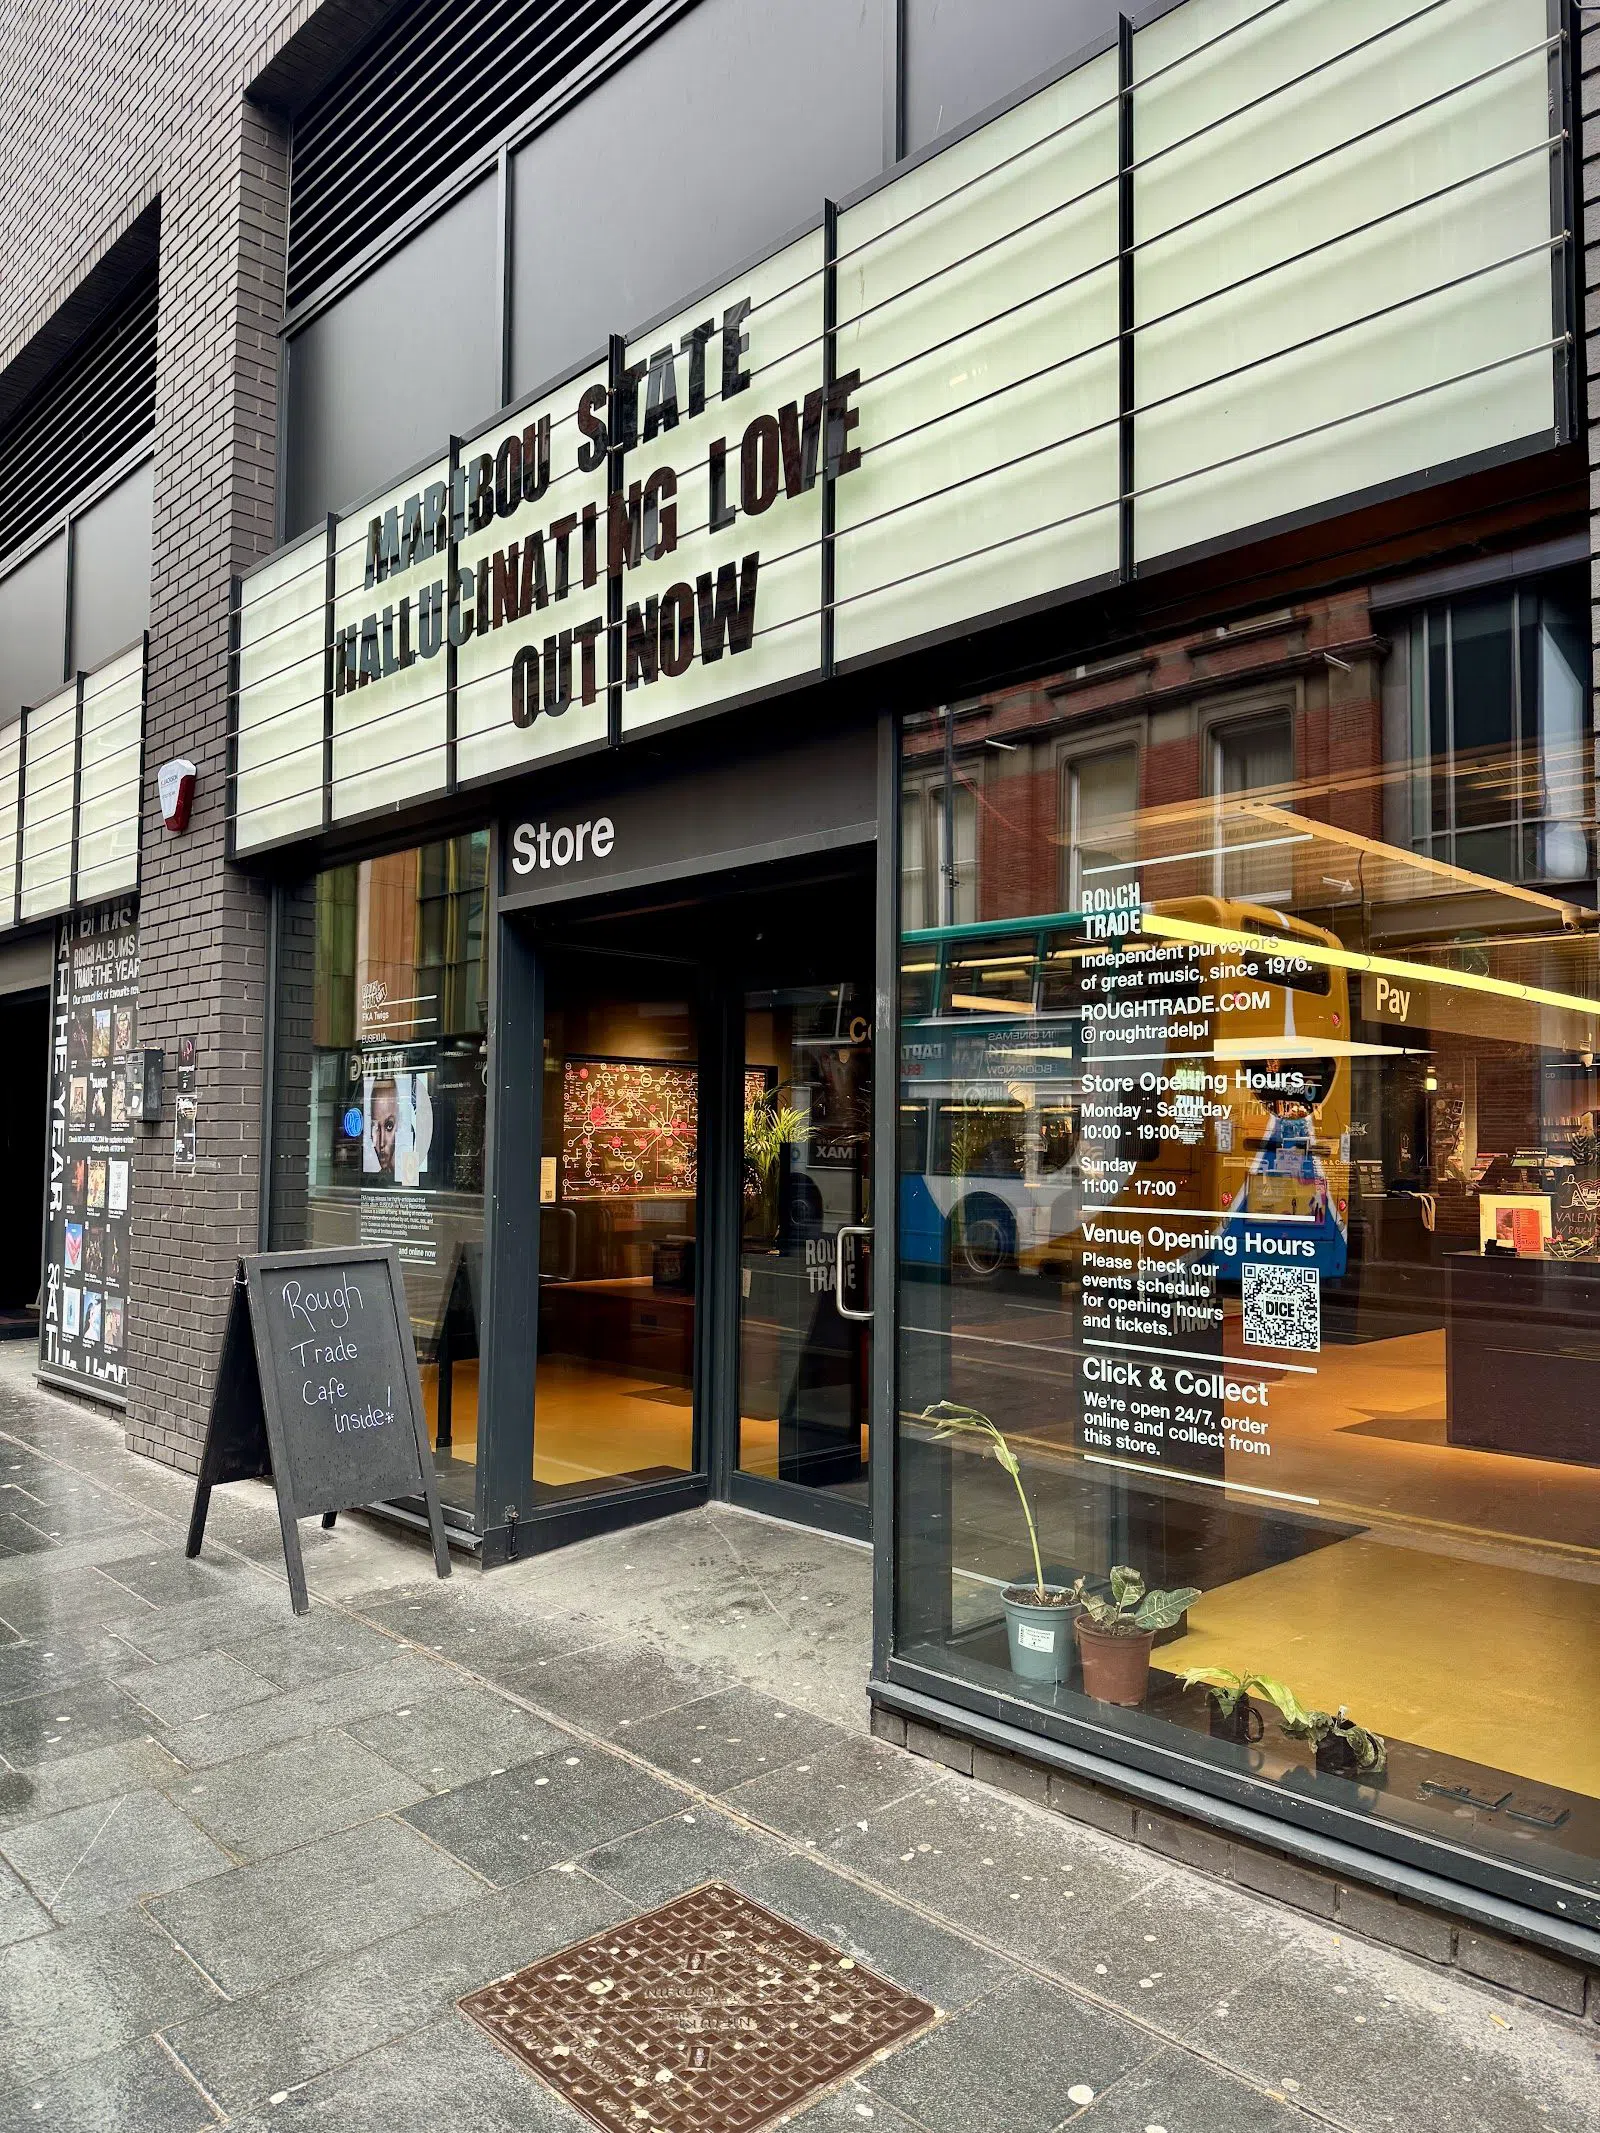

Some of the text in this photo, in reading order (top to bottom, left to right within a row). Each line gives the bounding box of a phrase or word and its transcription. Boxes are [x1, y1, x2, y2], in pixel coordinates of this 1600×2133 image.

[364, 296, 751, 590] MARIBOU STATE
[335, 368, 862, 697] HALLUCINATING LOVE
[510, 550, 760, 730] OUT NOW
[512, 817, 614, 874] Store
[1082, 882, 1140, 914] ROUGH
[1083, 909, 1141, 939] TRADE
[96, 934, 135, 962] ALBUMS
[1081, 936, 1279, 969] Independent purveyors
[1081, 956, 1313, 994] of great music, since 1976.
[1081, 991, 1271, 1021] ROUGHTRADE.COM
[1376, 977, 1410, 1022] Pay
[1100, 1020, 1210, 1044] roughtradelpl
[1081, 1072, 1134, 1093] Store
[1140, 1071, 1228, 1097] Opening
[1236, 1069, 1304, 1091] Hours
[1081, 1102, 1141, 1121] Monday
[1157, 1101, 1232, 1120] Saturday
[1081, 1125, 1121, 1140] 10:00
[1137, 1124, 1180, 1140] 19:00
[1081, 1157, 1137, 1176] Sunday
[1082, 1179, 1119, 1195] 11:00
[1134, 1181, 1176, 1197] 17:00
[399, 1247, 436, 1258] and online now
[806, 1236, 856, 1266] ROUH
[1082, 1223, 1316, 1257] Venue Opening Hours
[807, 1264, 857, 1294] TRAE
[1082, 1252, 1219, 1277] Please check our
[1082, 1274, 1211, 1298] events schedule
[282, 1272, 364, 1333] Rough
[1082, 1292, 1224, 1321] for opening hours
[1265, 1301, 1296, 1318] DICE
[1082, 1313, 1172, 1337] and tickets.
[290, 1336, 358, 1367] Trade
[302, 1377, 349, 1406] Cafe
[1082, 1357, 1269, 1406] Click & Collect
[1083, 1391, 1268, 1435] We're open 24/7, order
[1083, 1410, 1271, 1456] online and collect from
[1083, 1428, 1161, 1457] this store.
